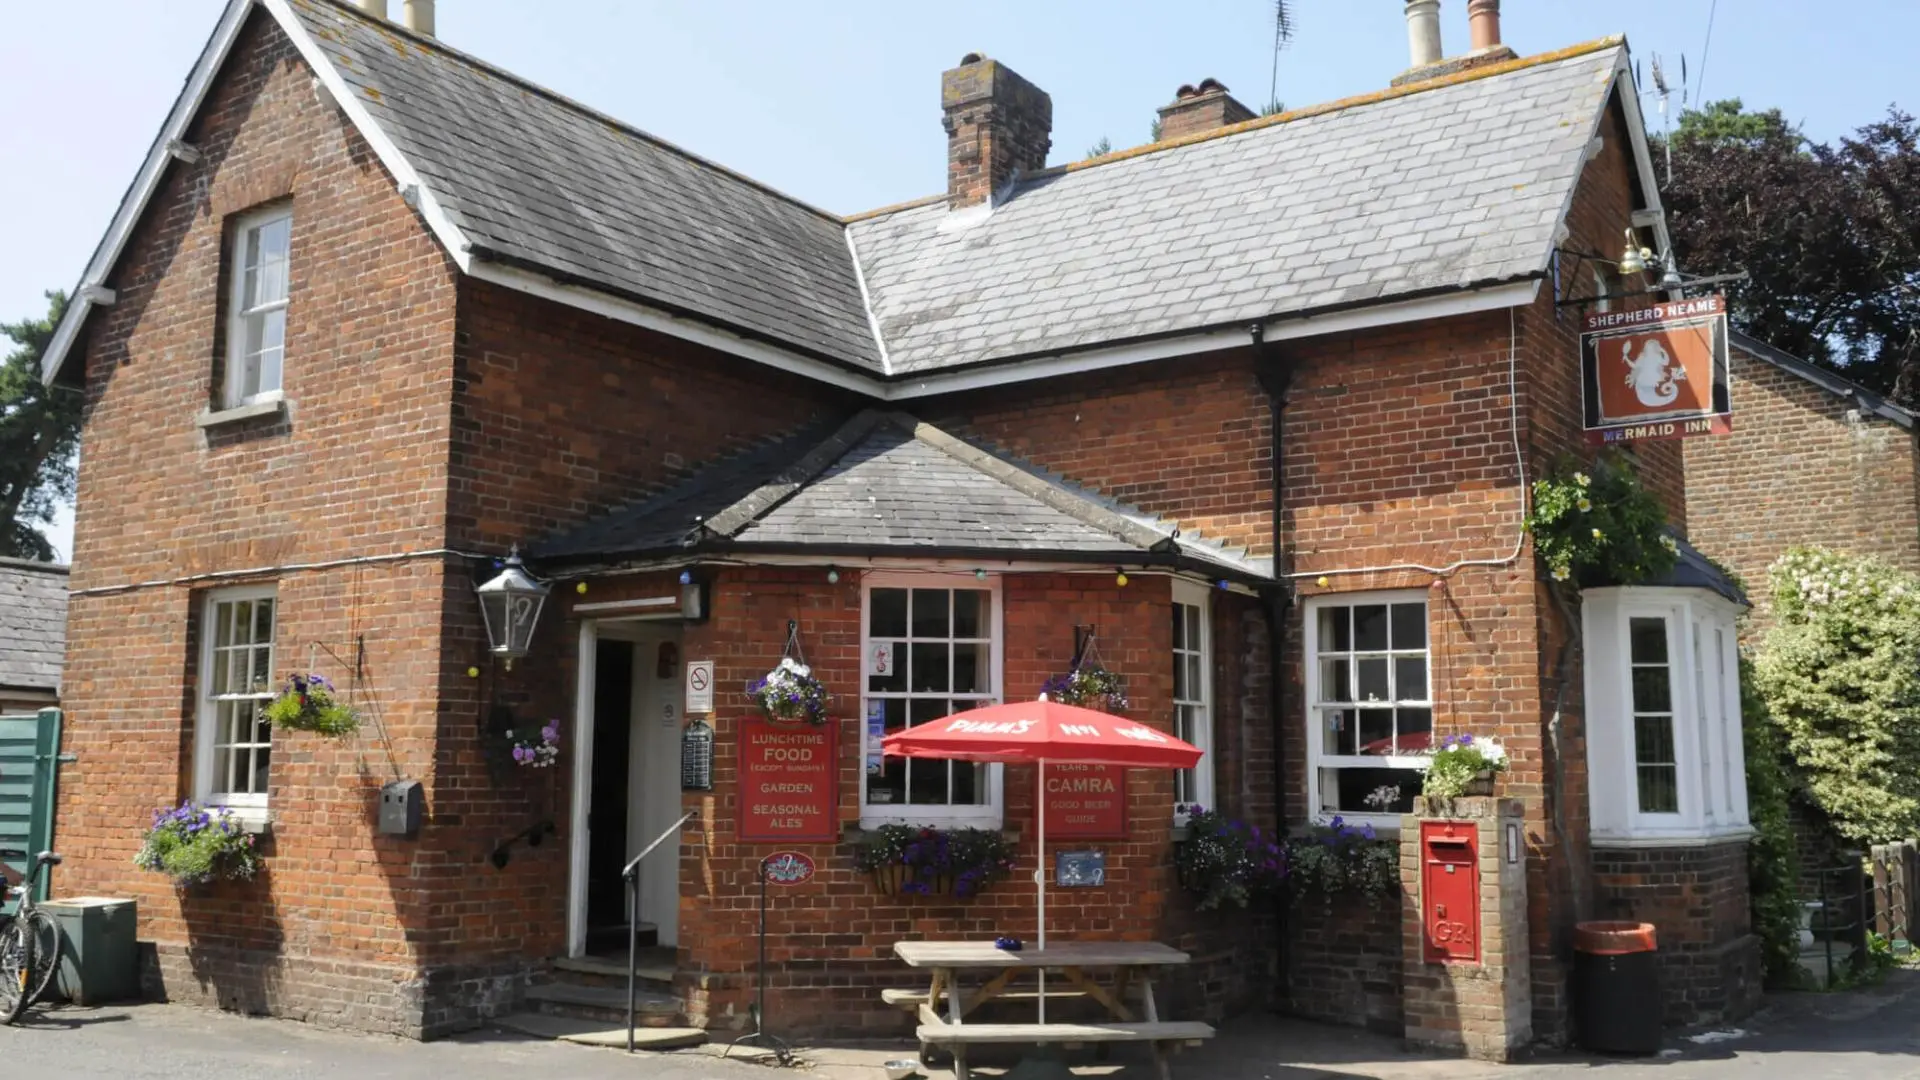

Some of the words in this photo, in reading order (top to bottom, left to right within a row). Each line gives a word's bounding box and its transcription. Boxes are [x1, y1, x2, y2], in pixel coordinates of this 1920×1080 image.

[1588, 307, 1663, 328] SHEPHERD
[1667, 299, 1717, 317] NEAME
[1603, 423, 1675, 442] MERMAID
[1685, 419, 1712, 433] INN
[752, 734, 824, 744] LUNCHTIME
[763, 748, 813, 762] FOOD
[1056, 764, 1089, 772] YEARS
[760, 783, 813, 793] GARDEN
[1046, 778, 1115, 793] CAMRA
[752, 804, 820, 815] SEASONAL
[1051, 801, 1080, 809] GOOD
[1085, 801, 1111, 809] BEER
[769, 818, 803, 829] ALES
[1065, 815, 1097, 824] GUIDE
